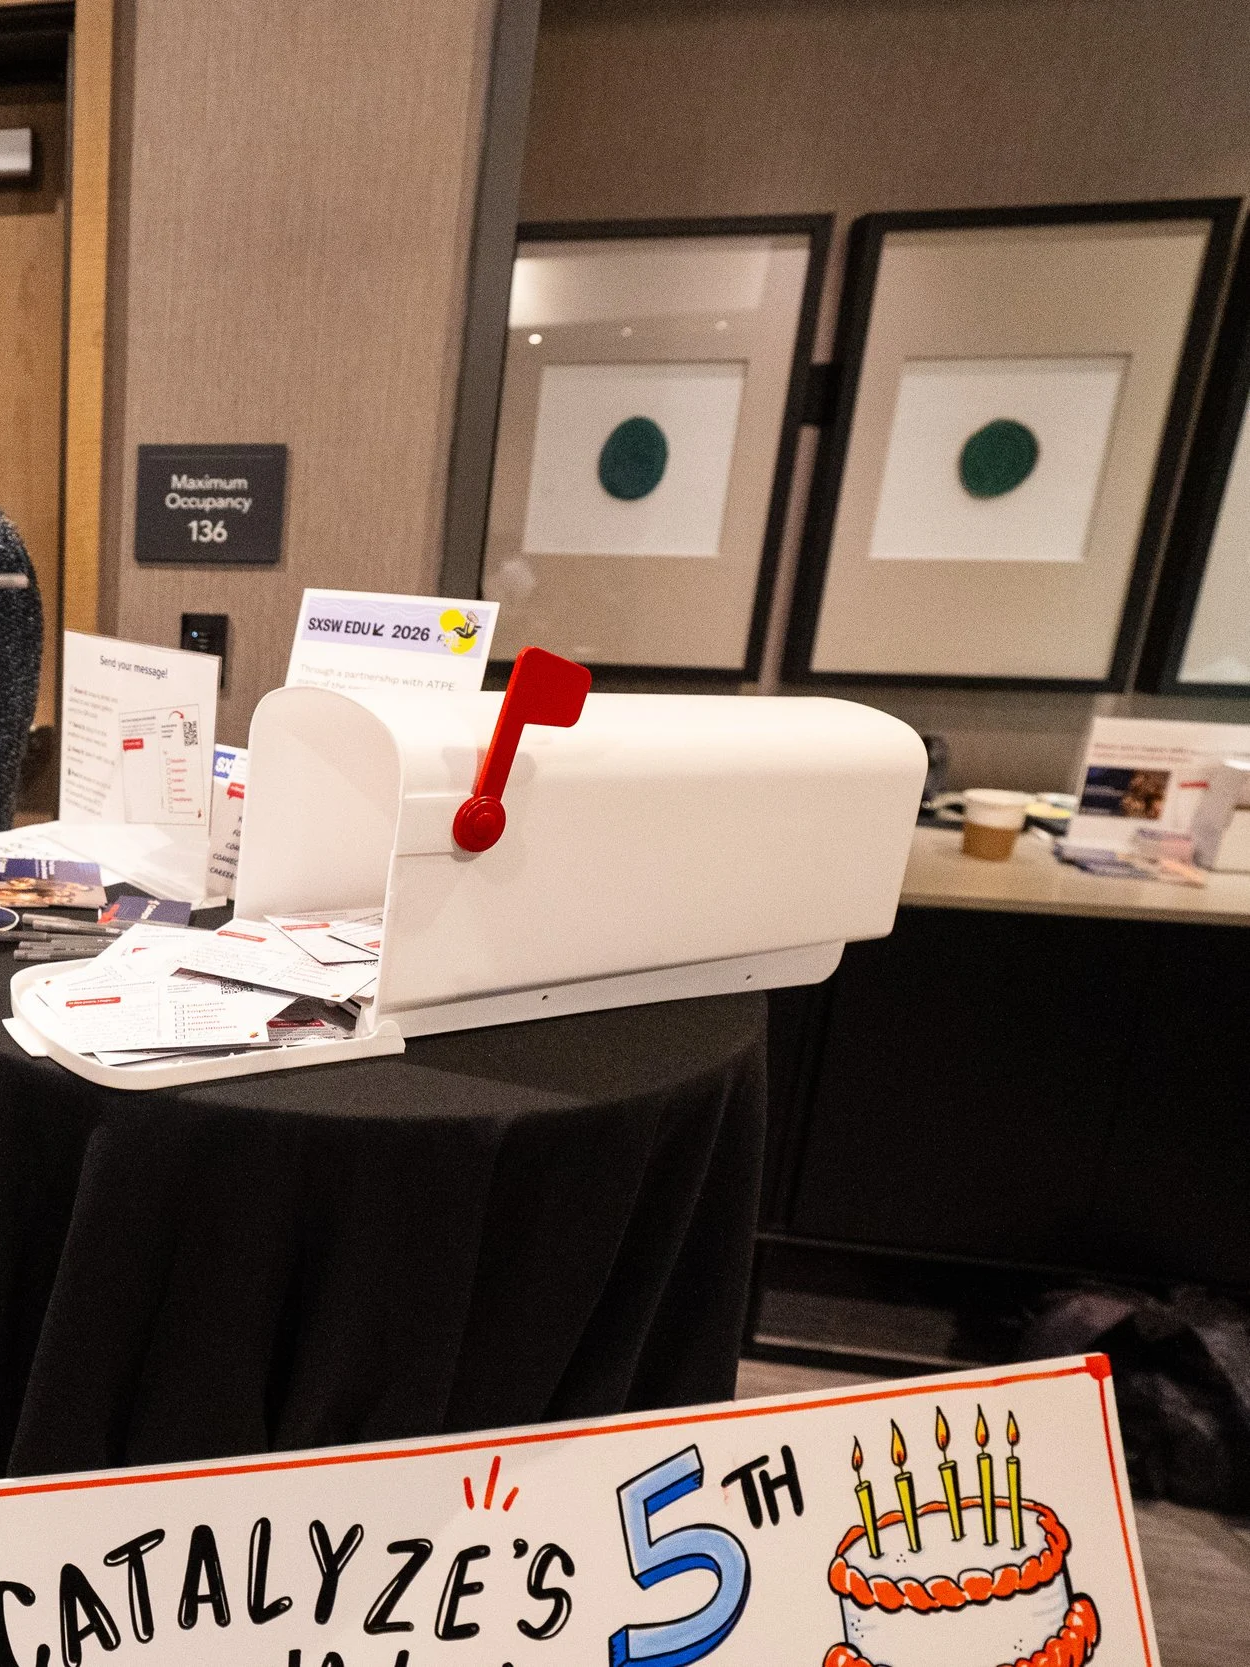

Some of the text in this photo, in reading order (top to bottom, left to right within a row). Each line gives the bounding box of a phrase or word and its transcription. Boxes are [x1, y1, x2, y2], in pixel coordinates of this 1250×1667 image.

[170, 474, 249, 491] Maximum
[164, 493, 253, 514] Occupancy
[187, 519, 229, 544] 136
[308, 617, 431, 642] SXSW EDU 2026
[99, 655, 169, 680] Send your message!
[300, 664, 336, 677] Through
[343, 669, 400, 686] partnership
[402, 677, 424, 689] with
[427, 679, 455, 692] ATPE
